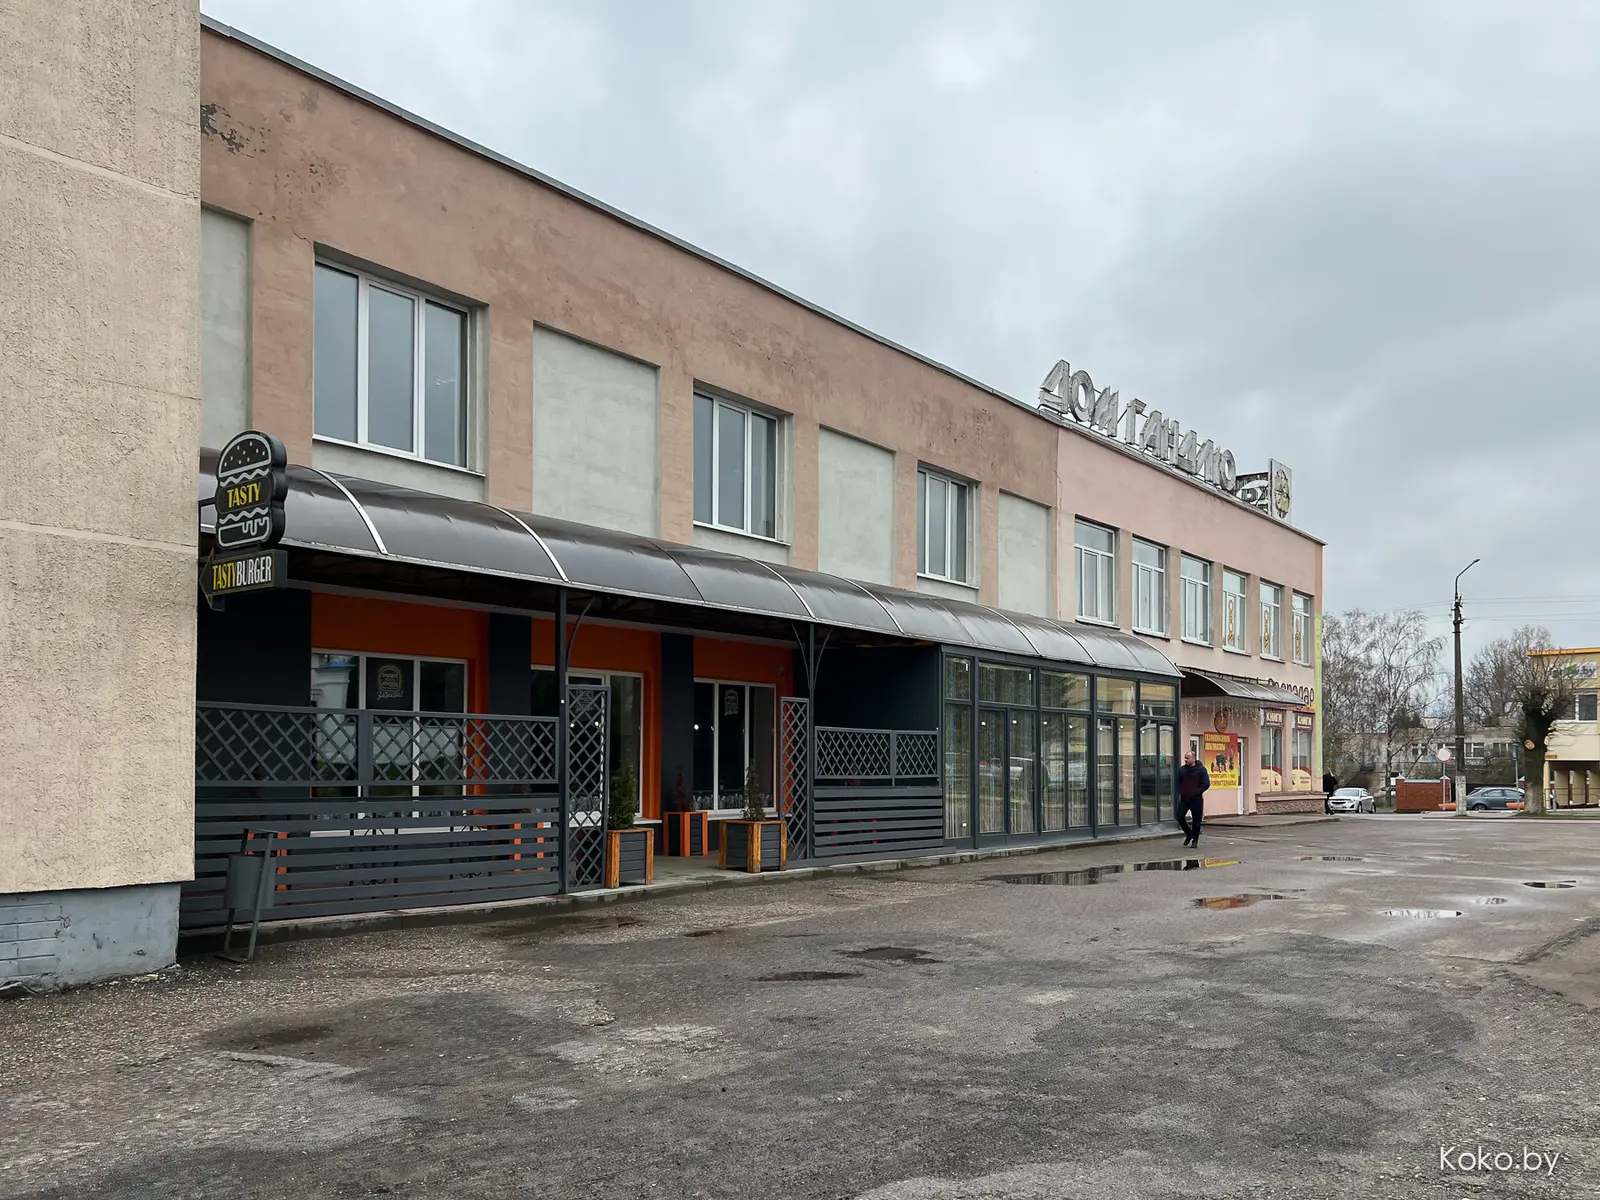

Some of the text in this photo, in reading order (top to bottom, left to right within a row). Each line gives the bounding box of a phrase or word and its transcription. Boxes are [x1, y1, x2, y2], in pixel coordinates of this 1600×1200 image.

[1038, 359, 1236, 491] ДОМ ГАНДЛЮ
[227, 482, 261, 509] TASTY
[212, 555, 272, 591] TASTYBURGER
